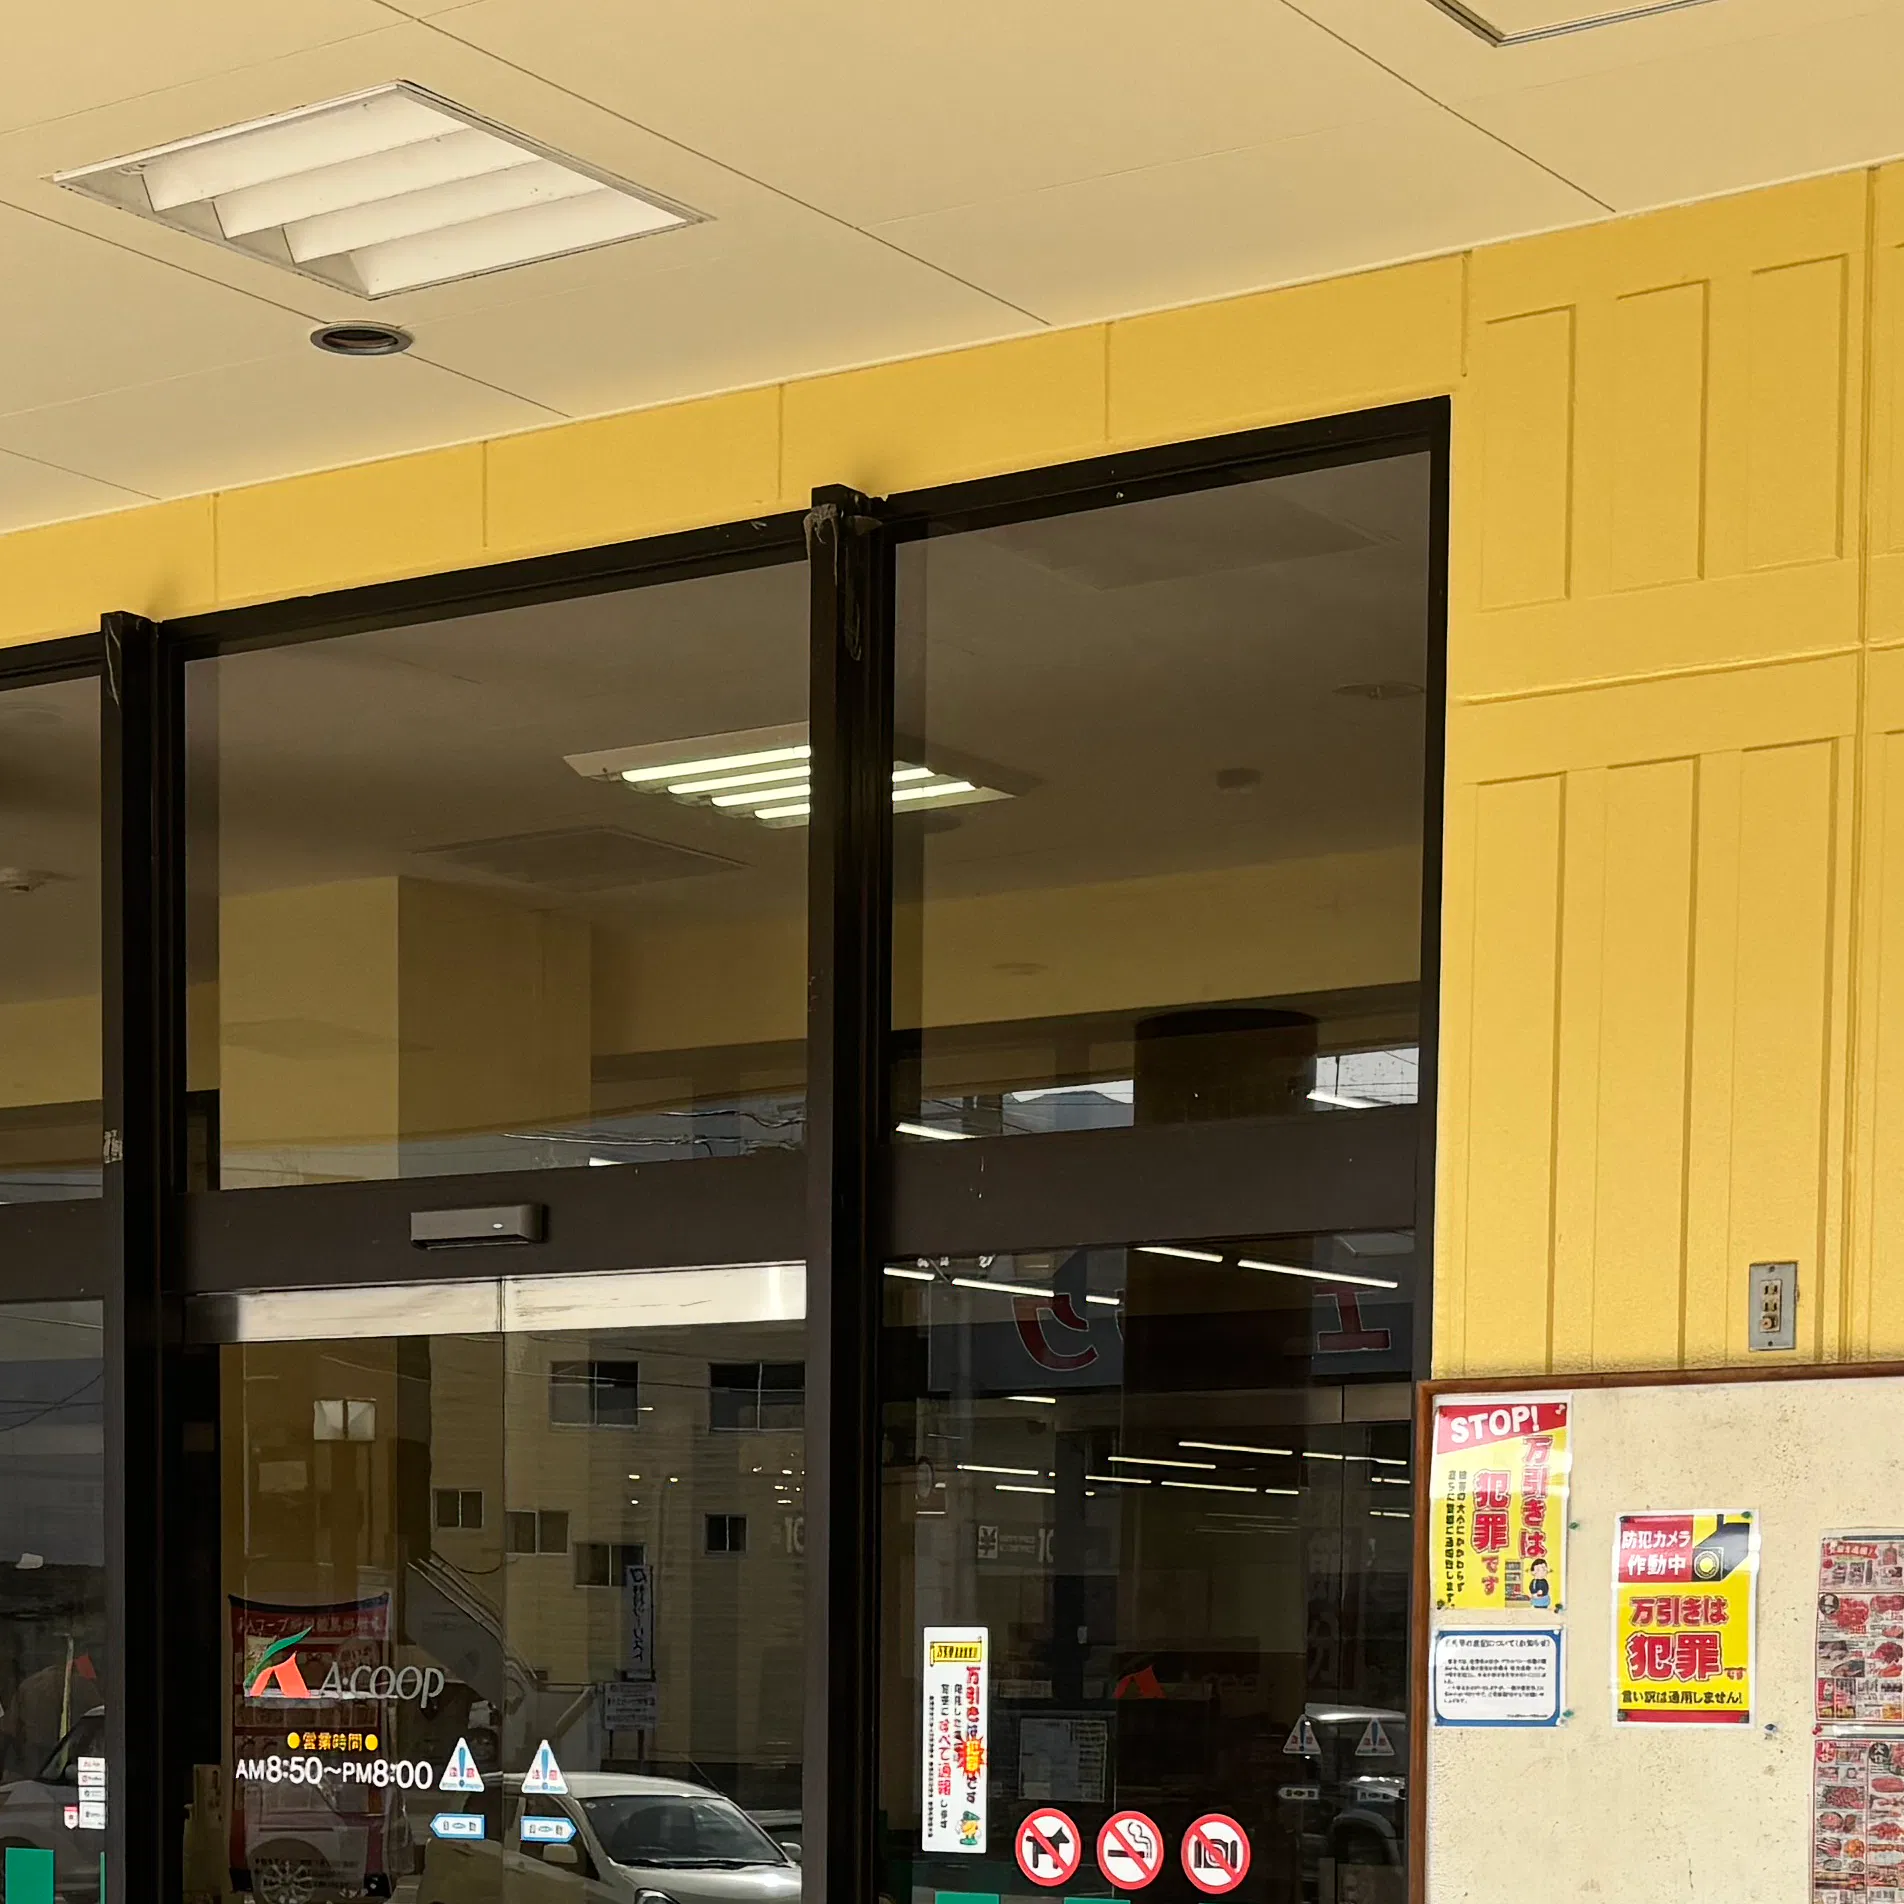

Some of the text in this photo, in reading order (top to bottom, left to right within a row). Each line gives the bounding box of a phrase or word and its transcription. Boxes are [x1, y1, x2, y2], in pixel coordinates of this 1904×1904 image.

[1451, 1406, 1539, 1444] STOP!
[1520, 1435, 1553, 1559] 万引きは
[1622, 1530, 1691, 1549] 防犯カメラ
[1627, 1554, 1686, 1576] 作動中
[1629, 1595, 1730, 1628] 万引きは
[302, 1732, 363, 1751] 営業時間
